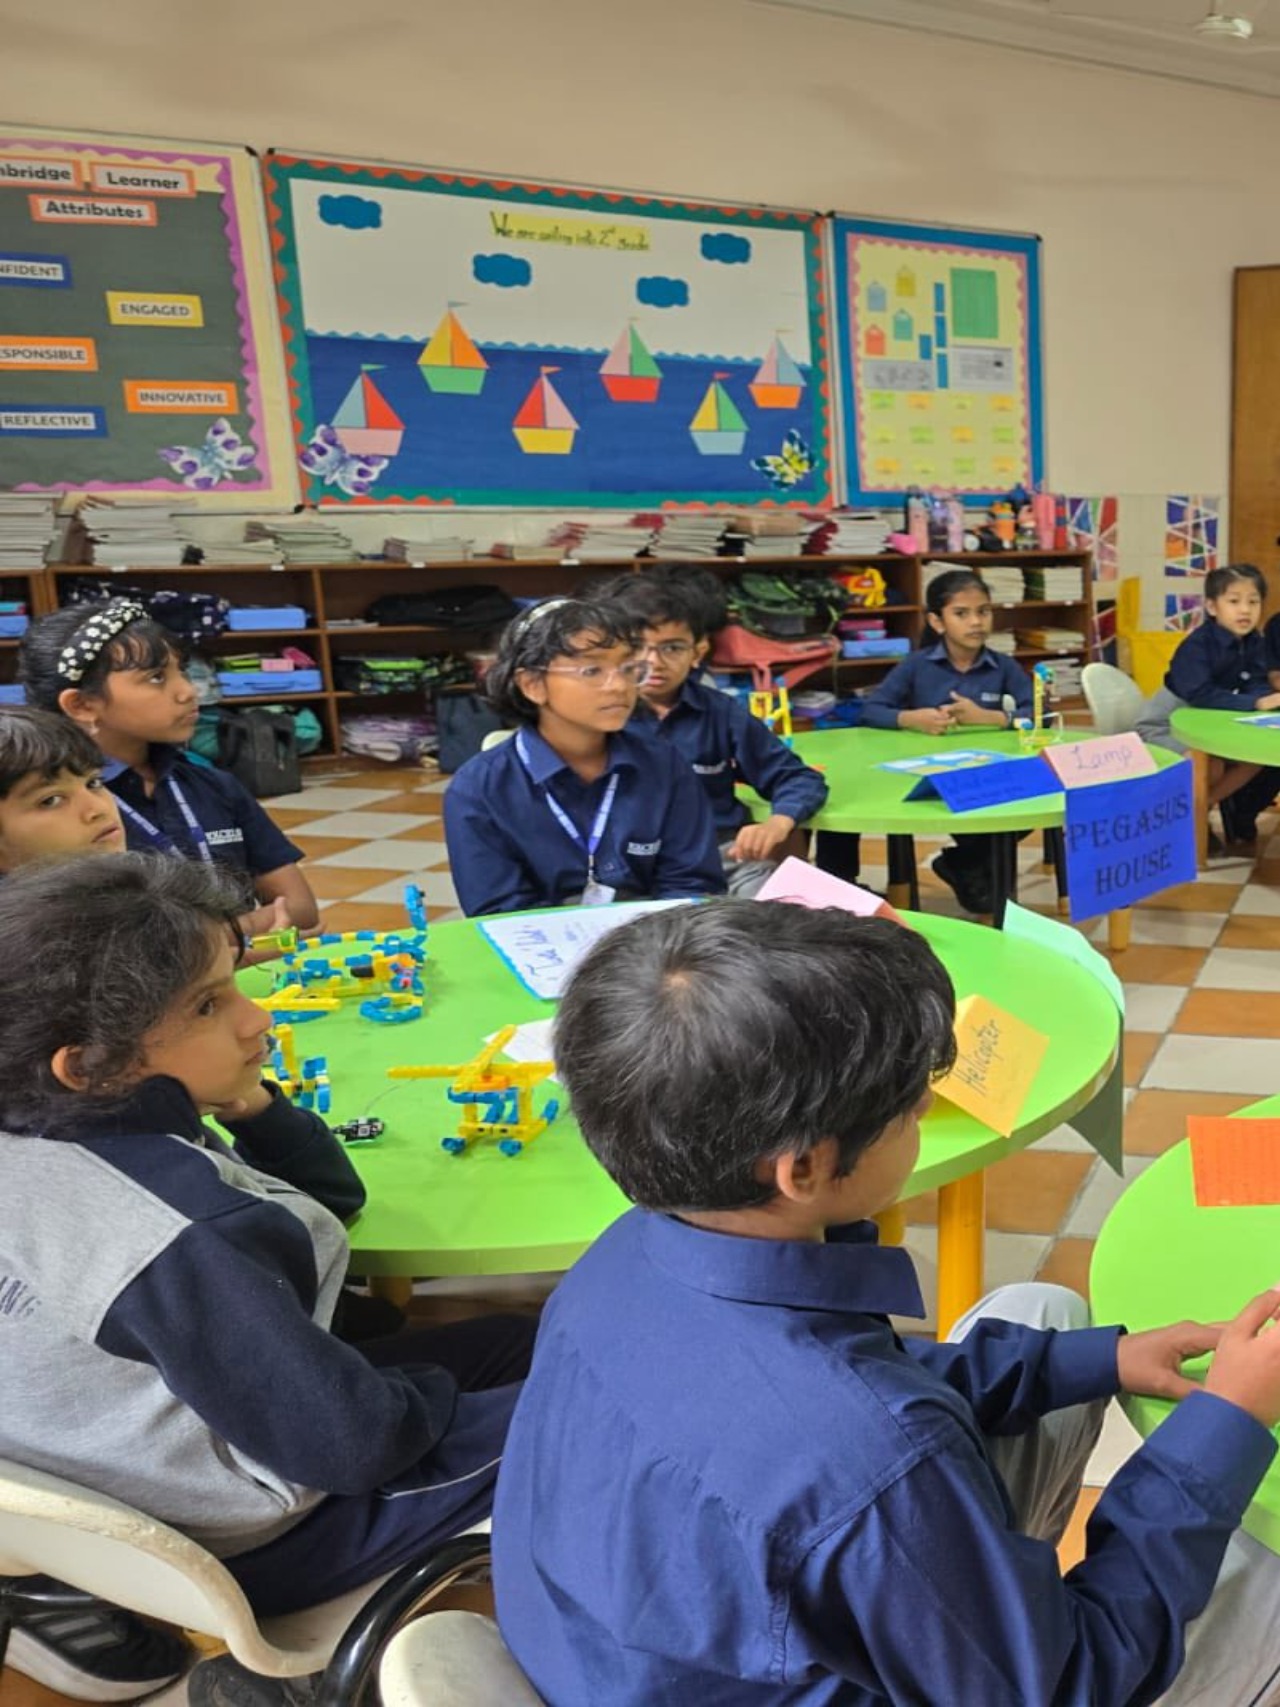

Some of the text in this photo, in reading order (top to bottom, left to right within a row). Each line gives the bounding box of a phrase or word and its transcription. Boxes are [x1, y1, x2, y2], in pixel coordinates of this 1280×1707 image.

[106, 171, 180, 189] Learner
[46, 200, 144, 219] Attributes
[119, 303, 190, 317] ENGAGED
[0, 348, 86, 361] SPONSIBLE
[139, 391, 225, 404] INNOVATIVE
[3, 414, 91, 427] REFLECTIVE
[1070, 745, 1133, 769] Lamp
[1067, 792, 1190, 853] PEGASUS
[1095, 843, 1172, 896] HOUSE
